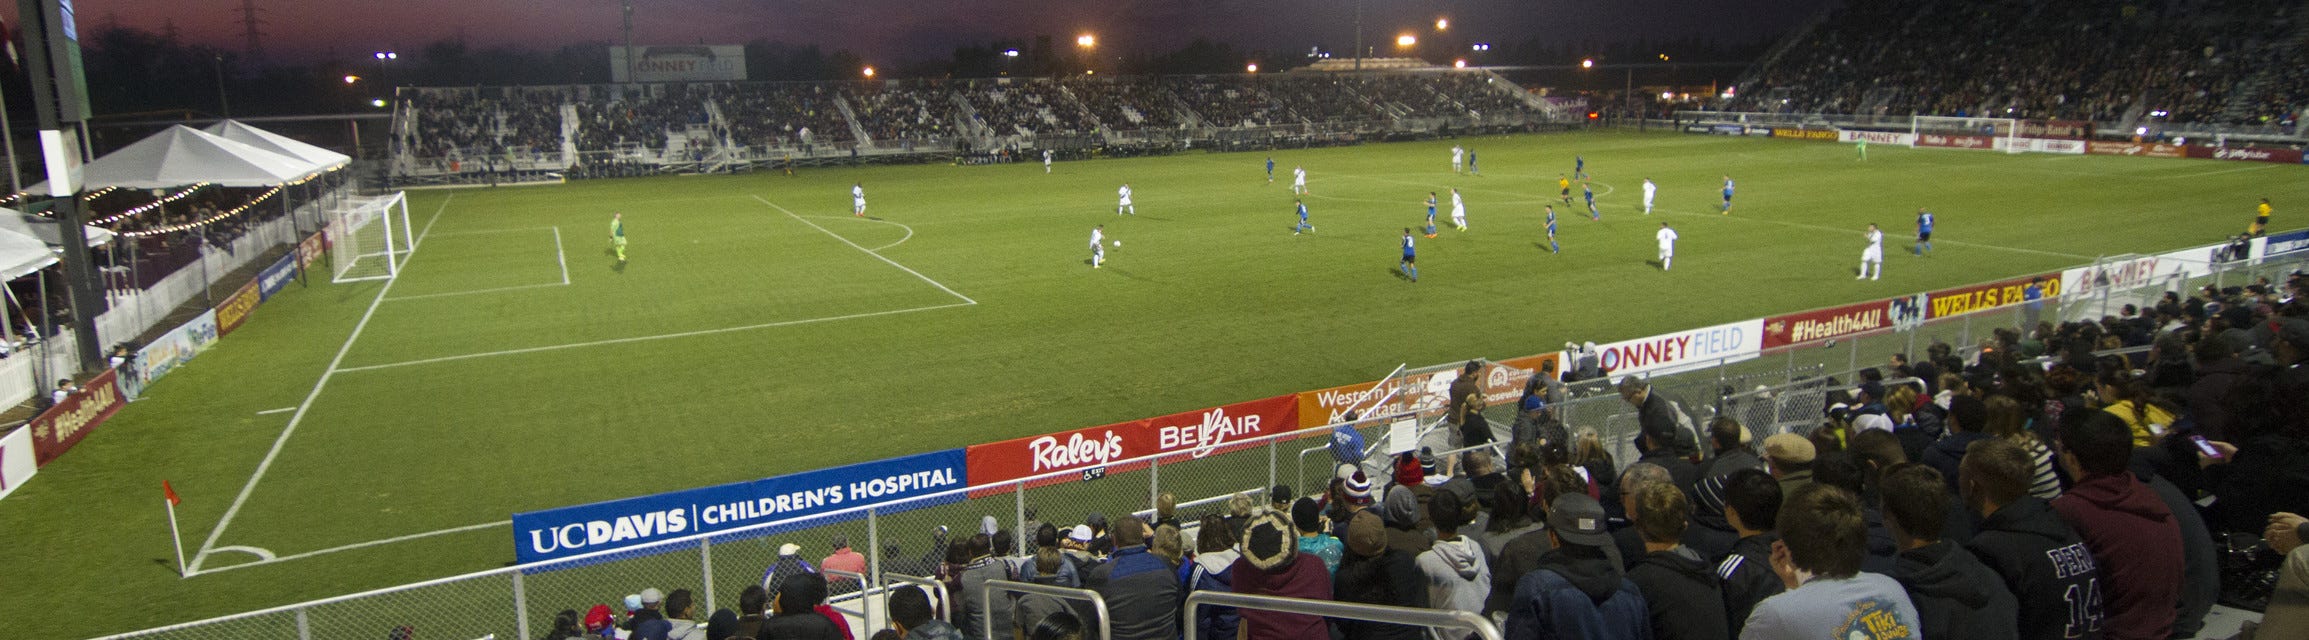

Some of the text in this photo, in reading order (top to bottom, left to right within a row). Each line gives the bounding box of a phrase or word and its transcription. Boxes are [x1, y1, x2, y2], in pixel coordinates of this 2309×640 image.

[1933, 278, 2060, 318] WELLS FAGO
[1791, 308, 1882, 343] #Health4All
[1601, 327, 1743, 373] ONNEY FIELD
[54, 381, 116, 443] #Health4All
[1029, 430, 1123, 471] Raley's
[1091, 467, 1105, 475] EXIT
[702, 484, 844, 525] CHILDREN'S
[850, 467, 957, 501] HOSPITAL
[2063, 578, 2104, 639] 14
